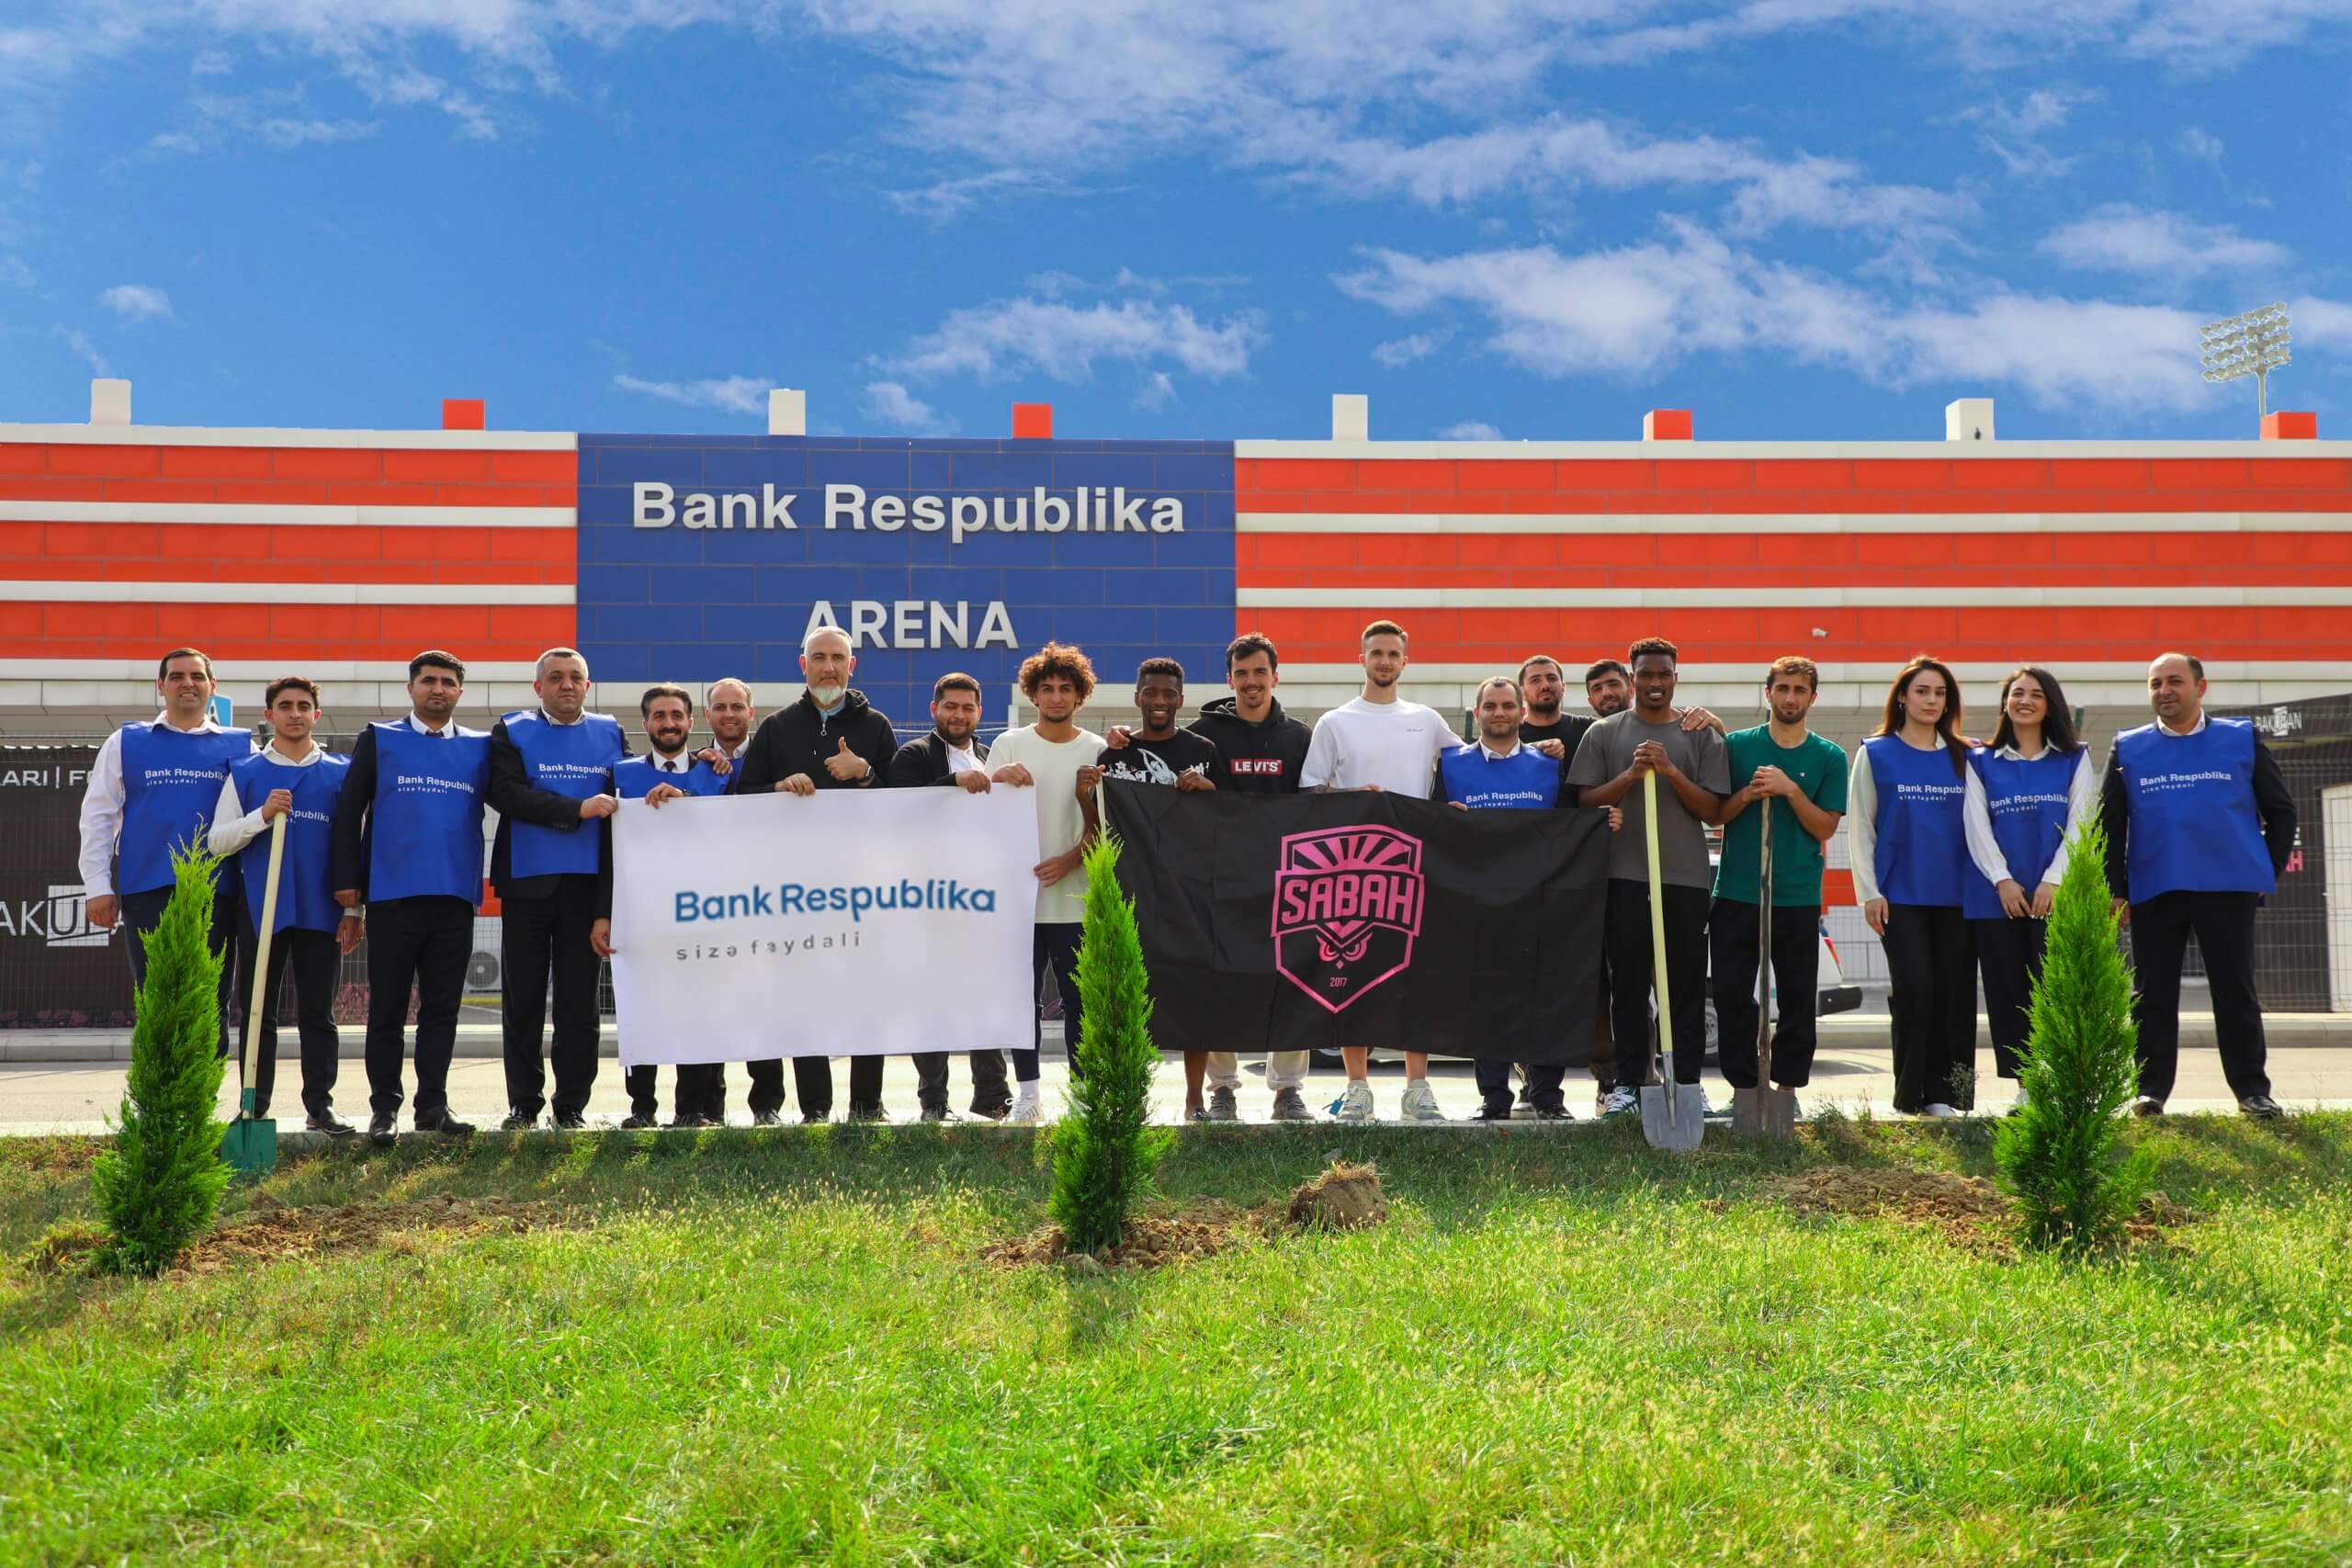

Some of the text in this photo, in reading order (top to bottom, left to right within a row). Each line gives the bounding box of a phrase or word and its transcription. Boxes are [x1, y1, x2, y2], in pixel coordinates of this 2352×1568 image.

[633, 481, 1184, 544] Bank Respublika
[800, 601, 1019, 649] ARENA
[538, 763, 564, 772] Bank
[1234, 761, 1279, 773] LEVI'S
[0, 770, 48, 786] ARI
[145, 769, 171, 779] Bank
[397, 775, 424, 784] Bank
[2140, 772, 2232, 786] Bank Respublika
[1897, 784, 1922, 793] Bank
[1465, 791, 1543, 803] Bank Respublika
[675, 879, 996, 922] Bank Respublika
[1282, 874, 1415, 925] SABAH
[676, 945, 737, 960] sizə
[1329, 977, 1347, 987] 2017
